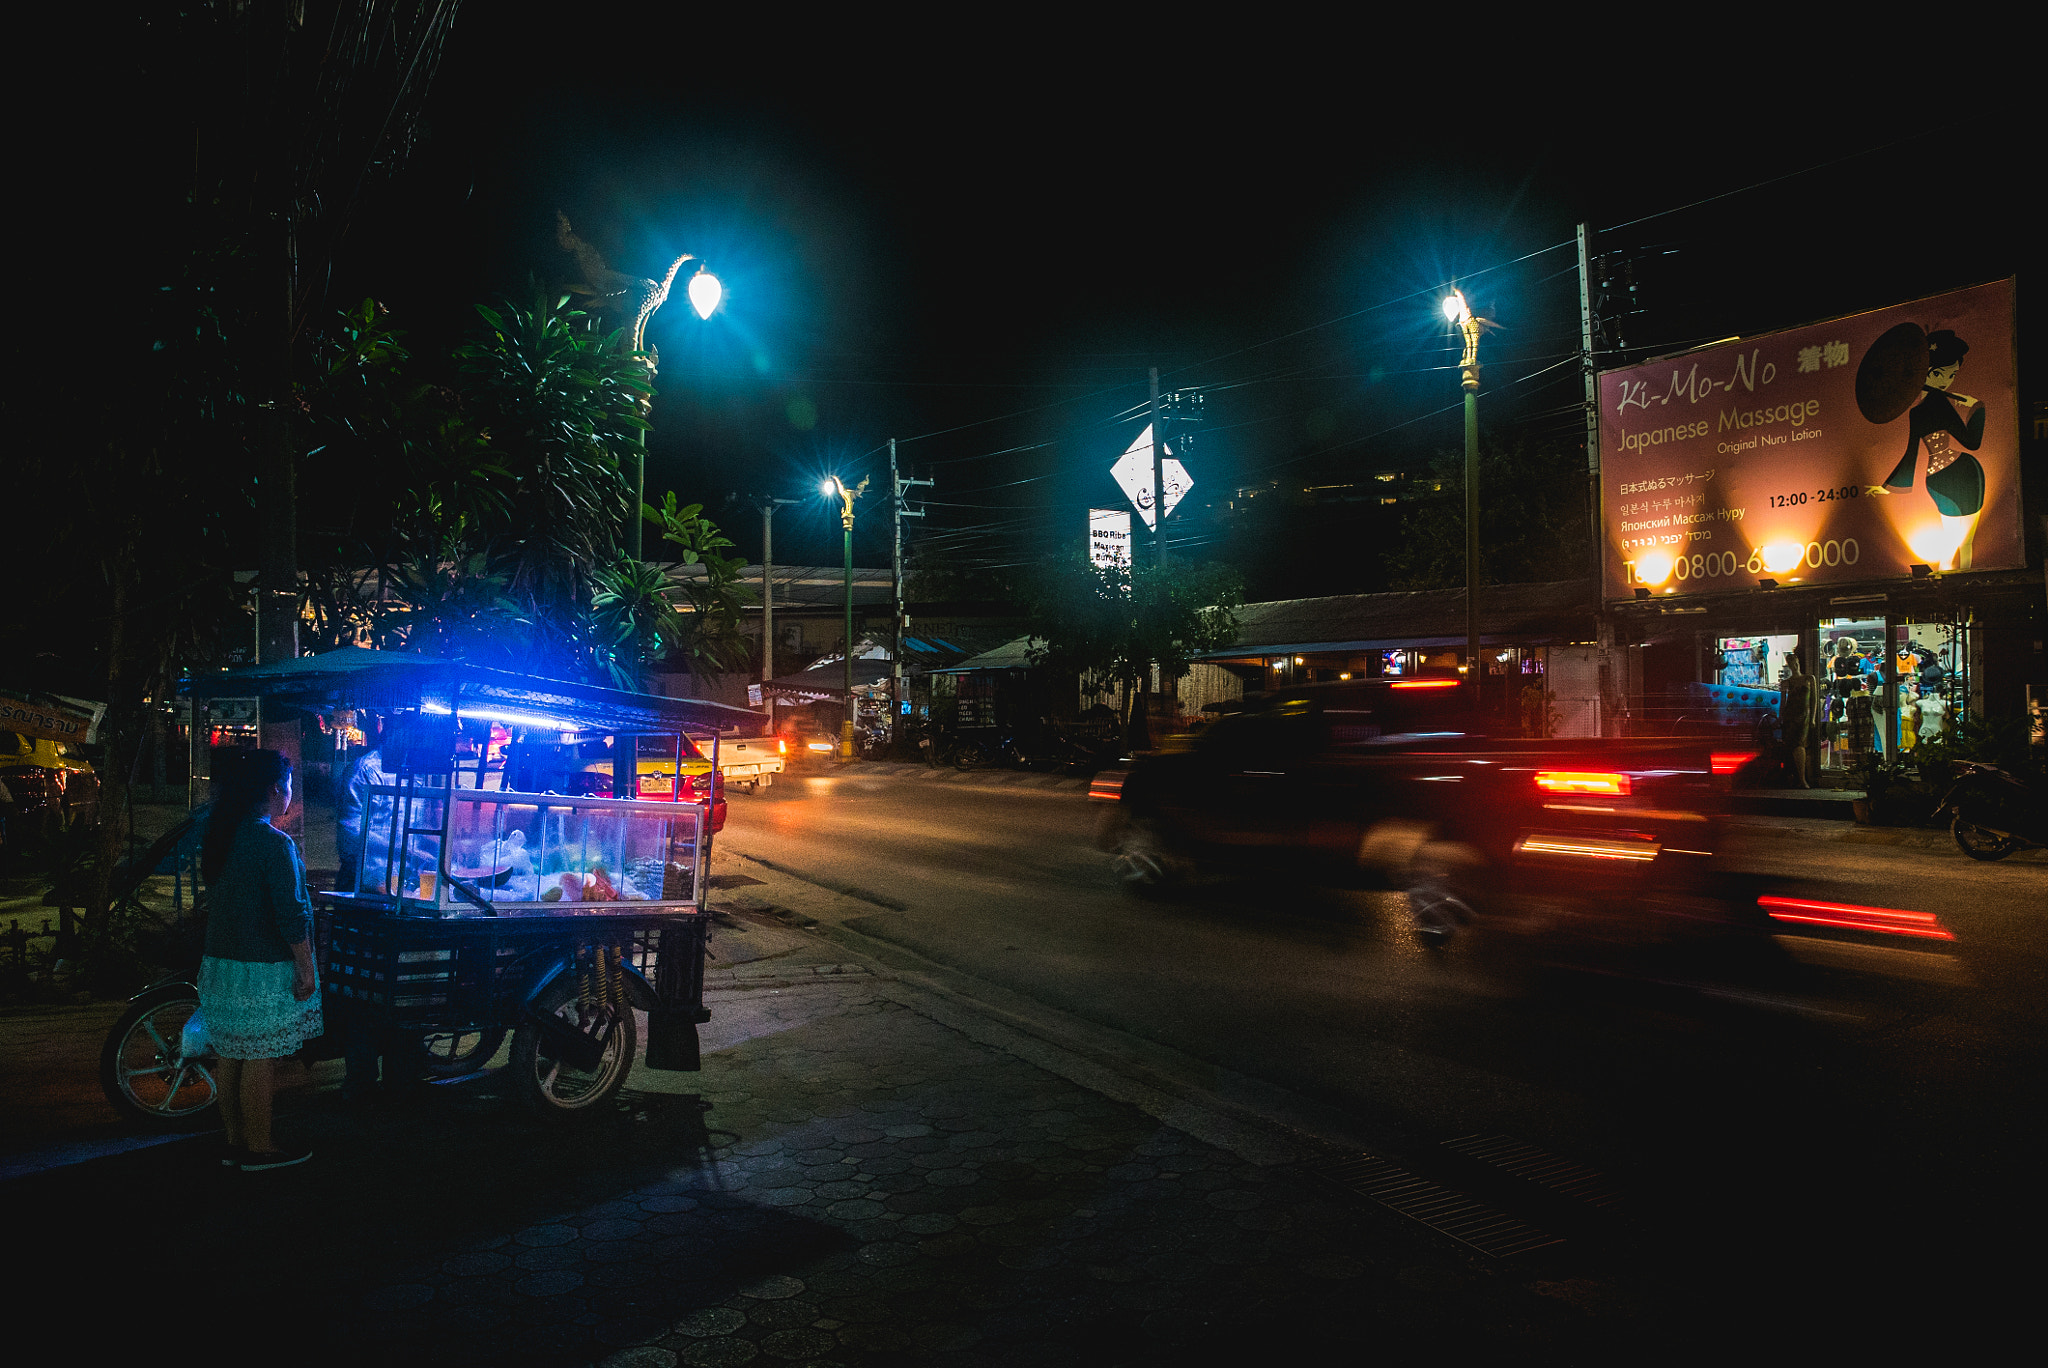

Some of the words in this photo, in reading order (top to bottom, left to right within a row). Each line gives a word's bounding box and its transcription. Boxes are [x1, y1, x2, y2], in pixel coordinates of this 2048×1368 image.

[1797, 340, 1849, 373] 着物
[1616, 348, 1776, 416] Ki-Mo-No
[1617, 420, 1709, 455] Japanese
[1717, 400, 1820, 433] Massage
[1717, 435, 1758, 455] Original
[1761, 434, 1788, 448] Nuru
[1791, 427, 1823, 443] Lotion
[1620, 468, 1716, 496] 日本式ぬるマッサージ
[1620, 501, 1649, 516] 일본식
[1652, 498, 1672, 512] 누루
[1674, 493, 1705, 508] 마사지
[1770, 492, 1808, 508] 12:00
[1817, 485, 1859, 502] 24:00
[1621, 515, 1670, 532] Японский
[1672, 511, 1715, 526] Массаж
[1717, 507, 1746, 522] Нуру
[1092, 530, 1109, 538] BBQ
